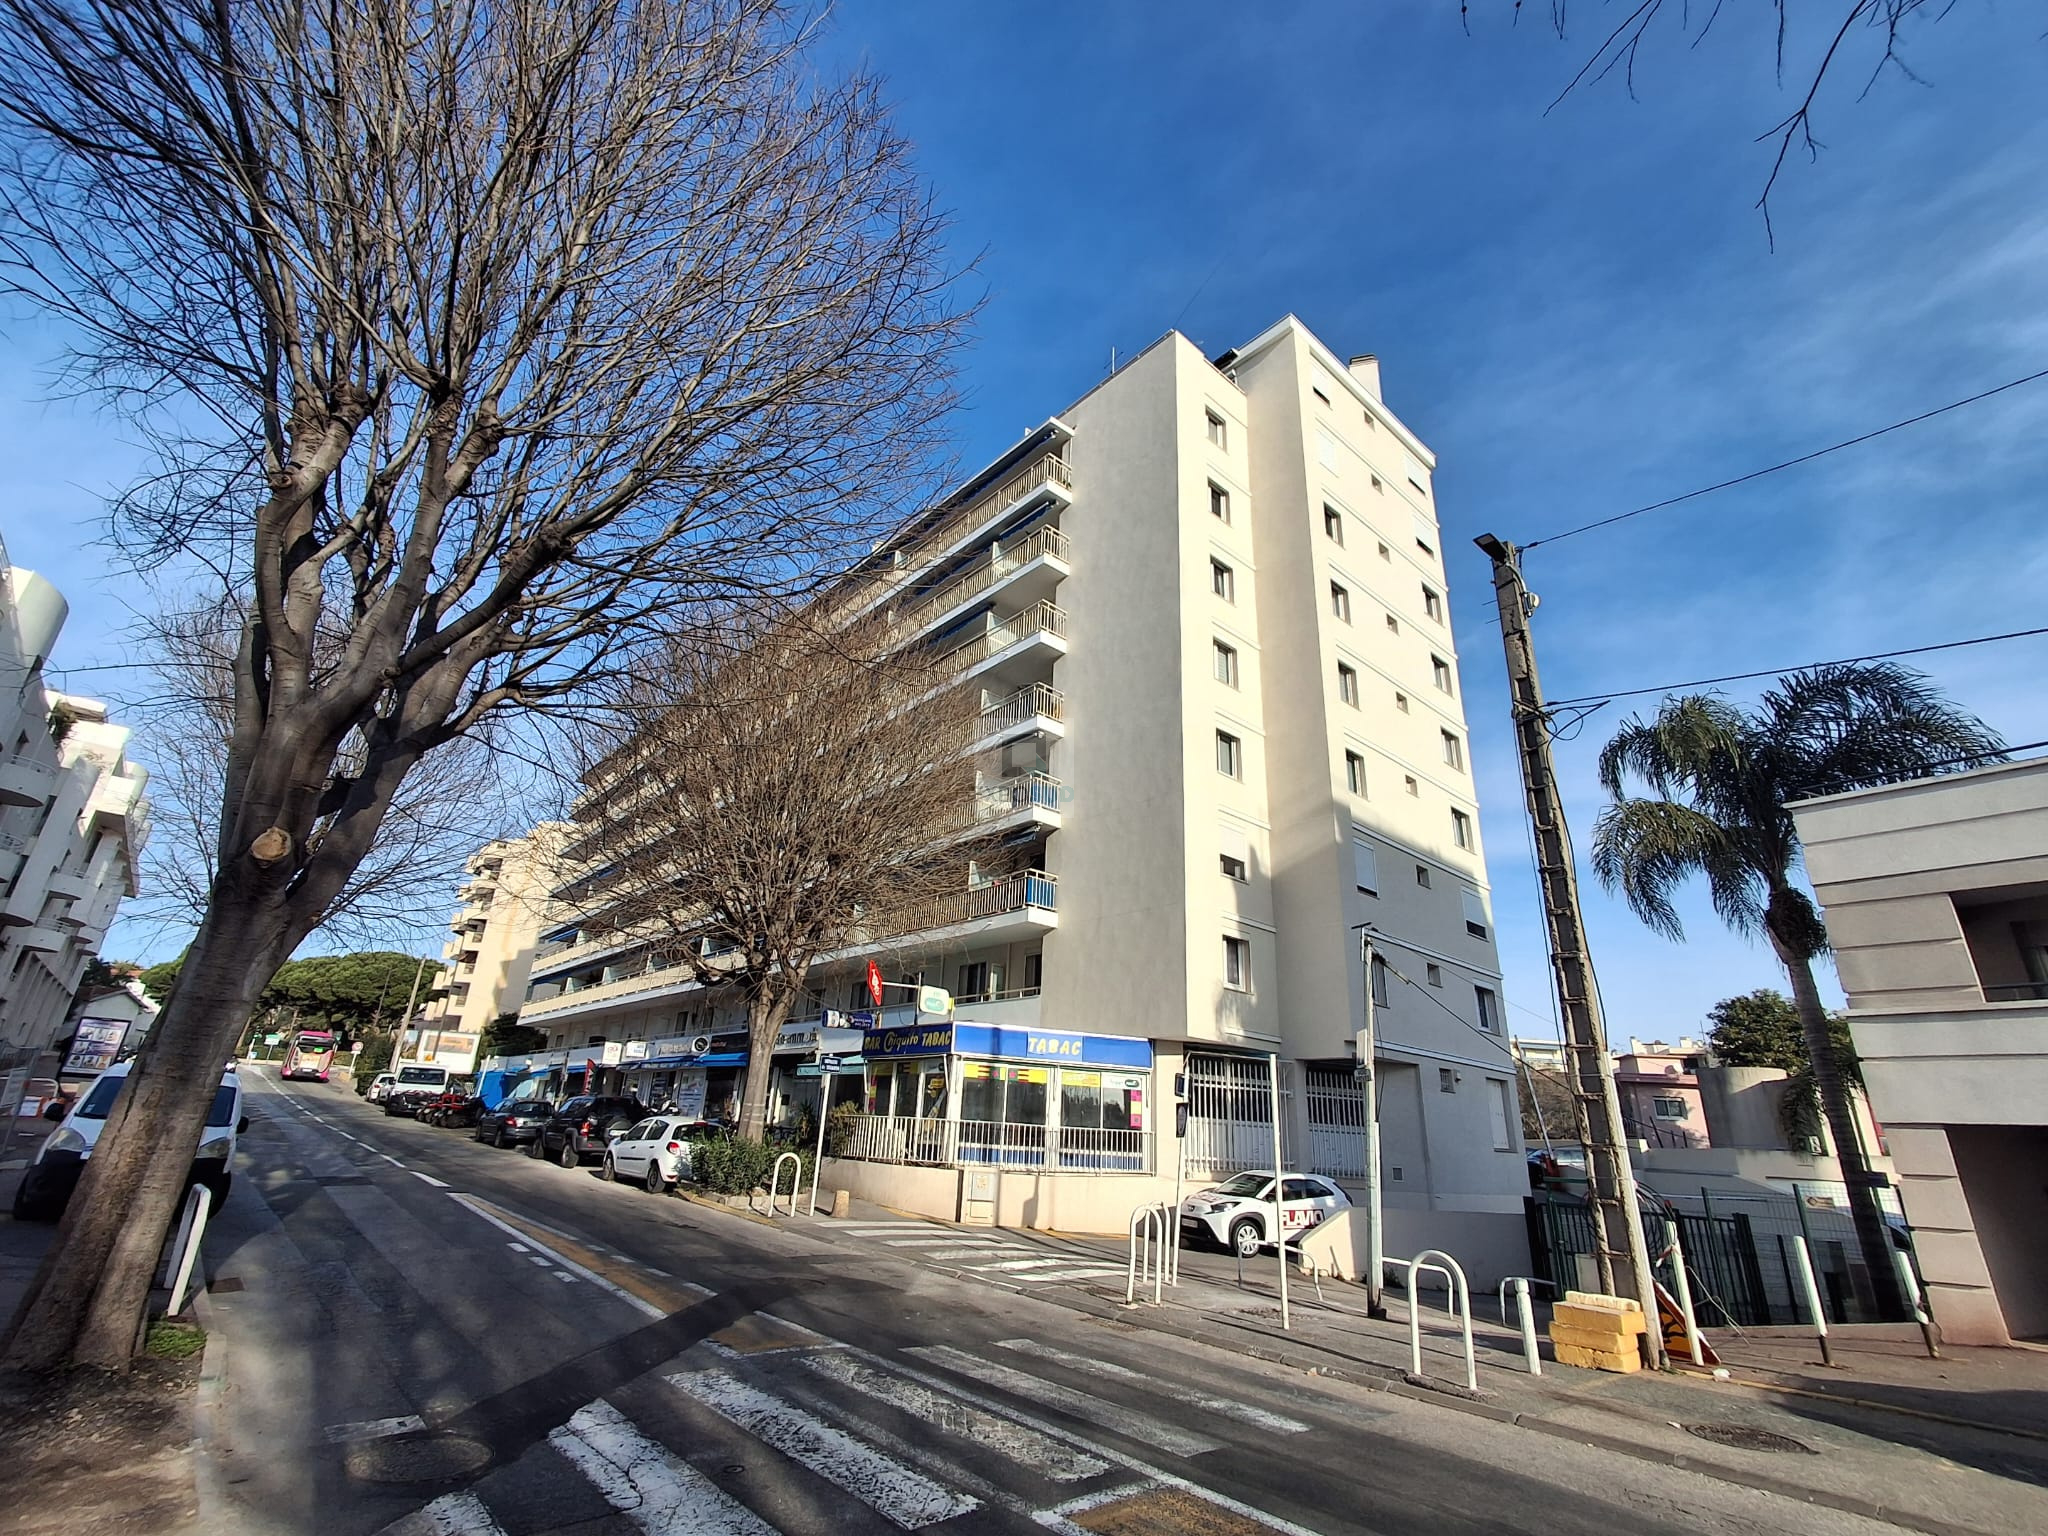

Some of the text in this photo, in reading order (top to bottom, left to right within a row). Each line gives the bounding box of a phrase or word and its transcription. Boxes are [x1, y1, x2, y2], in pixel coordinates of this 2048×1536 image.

[864, 1030, 952, 1053] BAR Chiquito TABAC
[1028, 1037, 1081, 1056] TABAC
